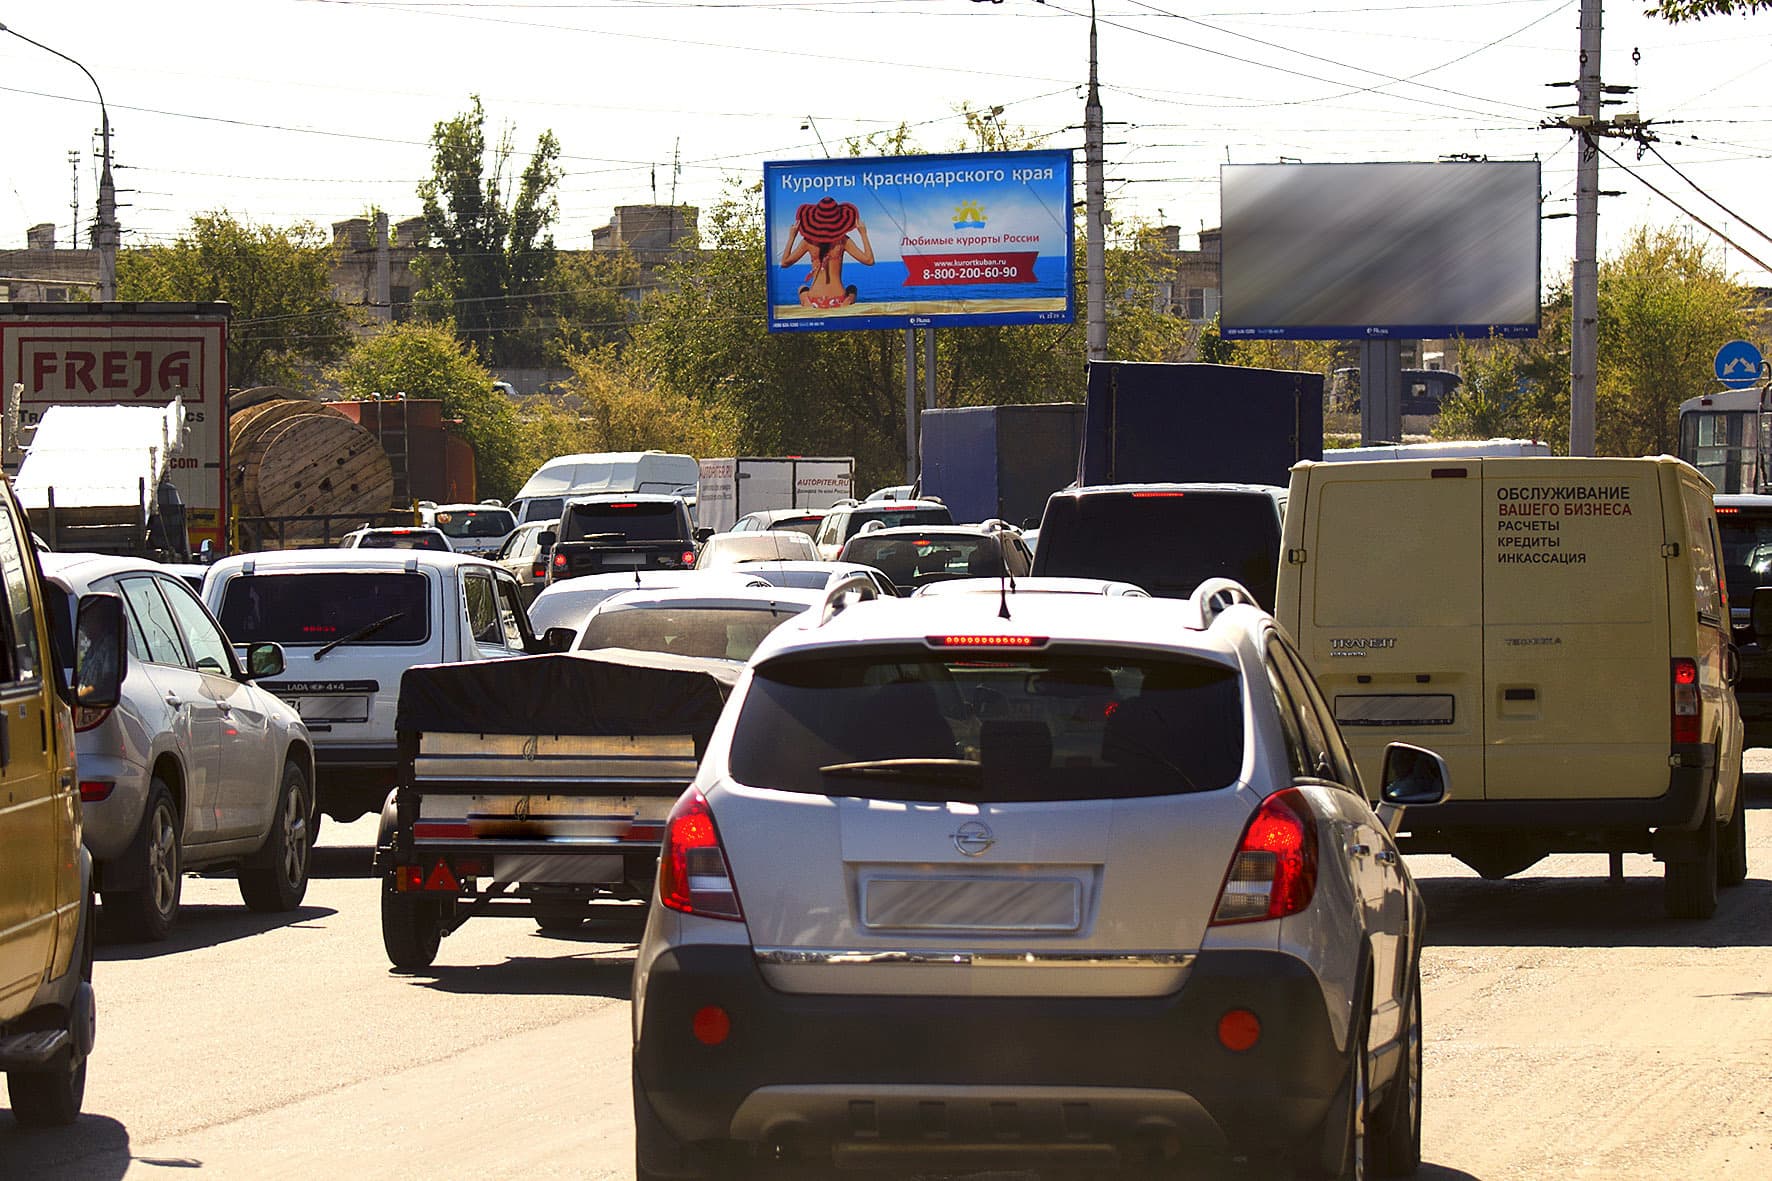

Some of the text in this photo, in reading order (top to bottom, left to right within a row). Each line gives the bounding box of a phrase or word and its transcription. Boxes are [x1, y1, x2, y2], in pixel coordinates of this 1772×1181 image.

[781, 168, 1054, 193] Курорты Краснодарского края
[901, 233, 1040, 246] Любимые курорты России
[922, 267, 1018, 280] 8-800-200-60-90
[33, 351, 191, 397] FREJA
[797, 479, 849, 487] AUTOPITER.RU
[1497, 487, 1631, 500] ОБСЛУЖИВАНИЕ
[1498, 503, 1633, 516] ВАШЕГО БИЗНЕСА
[1497, 521, 1560, 531] РАСЧЕТЫ
[1497, 537, 1560, 548] КРЕДИТЫ
[1497, 553, 1587, 565] ИНКАССАЦИЯ
[1329, 638, 1397, 649] TRANSIT
[287, 683, 309, 691] LADA
